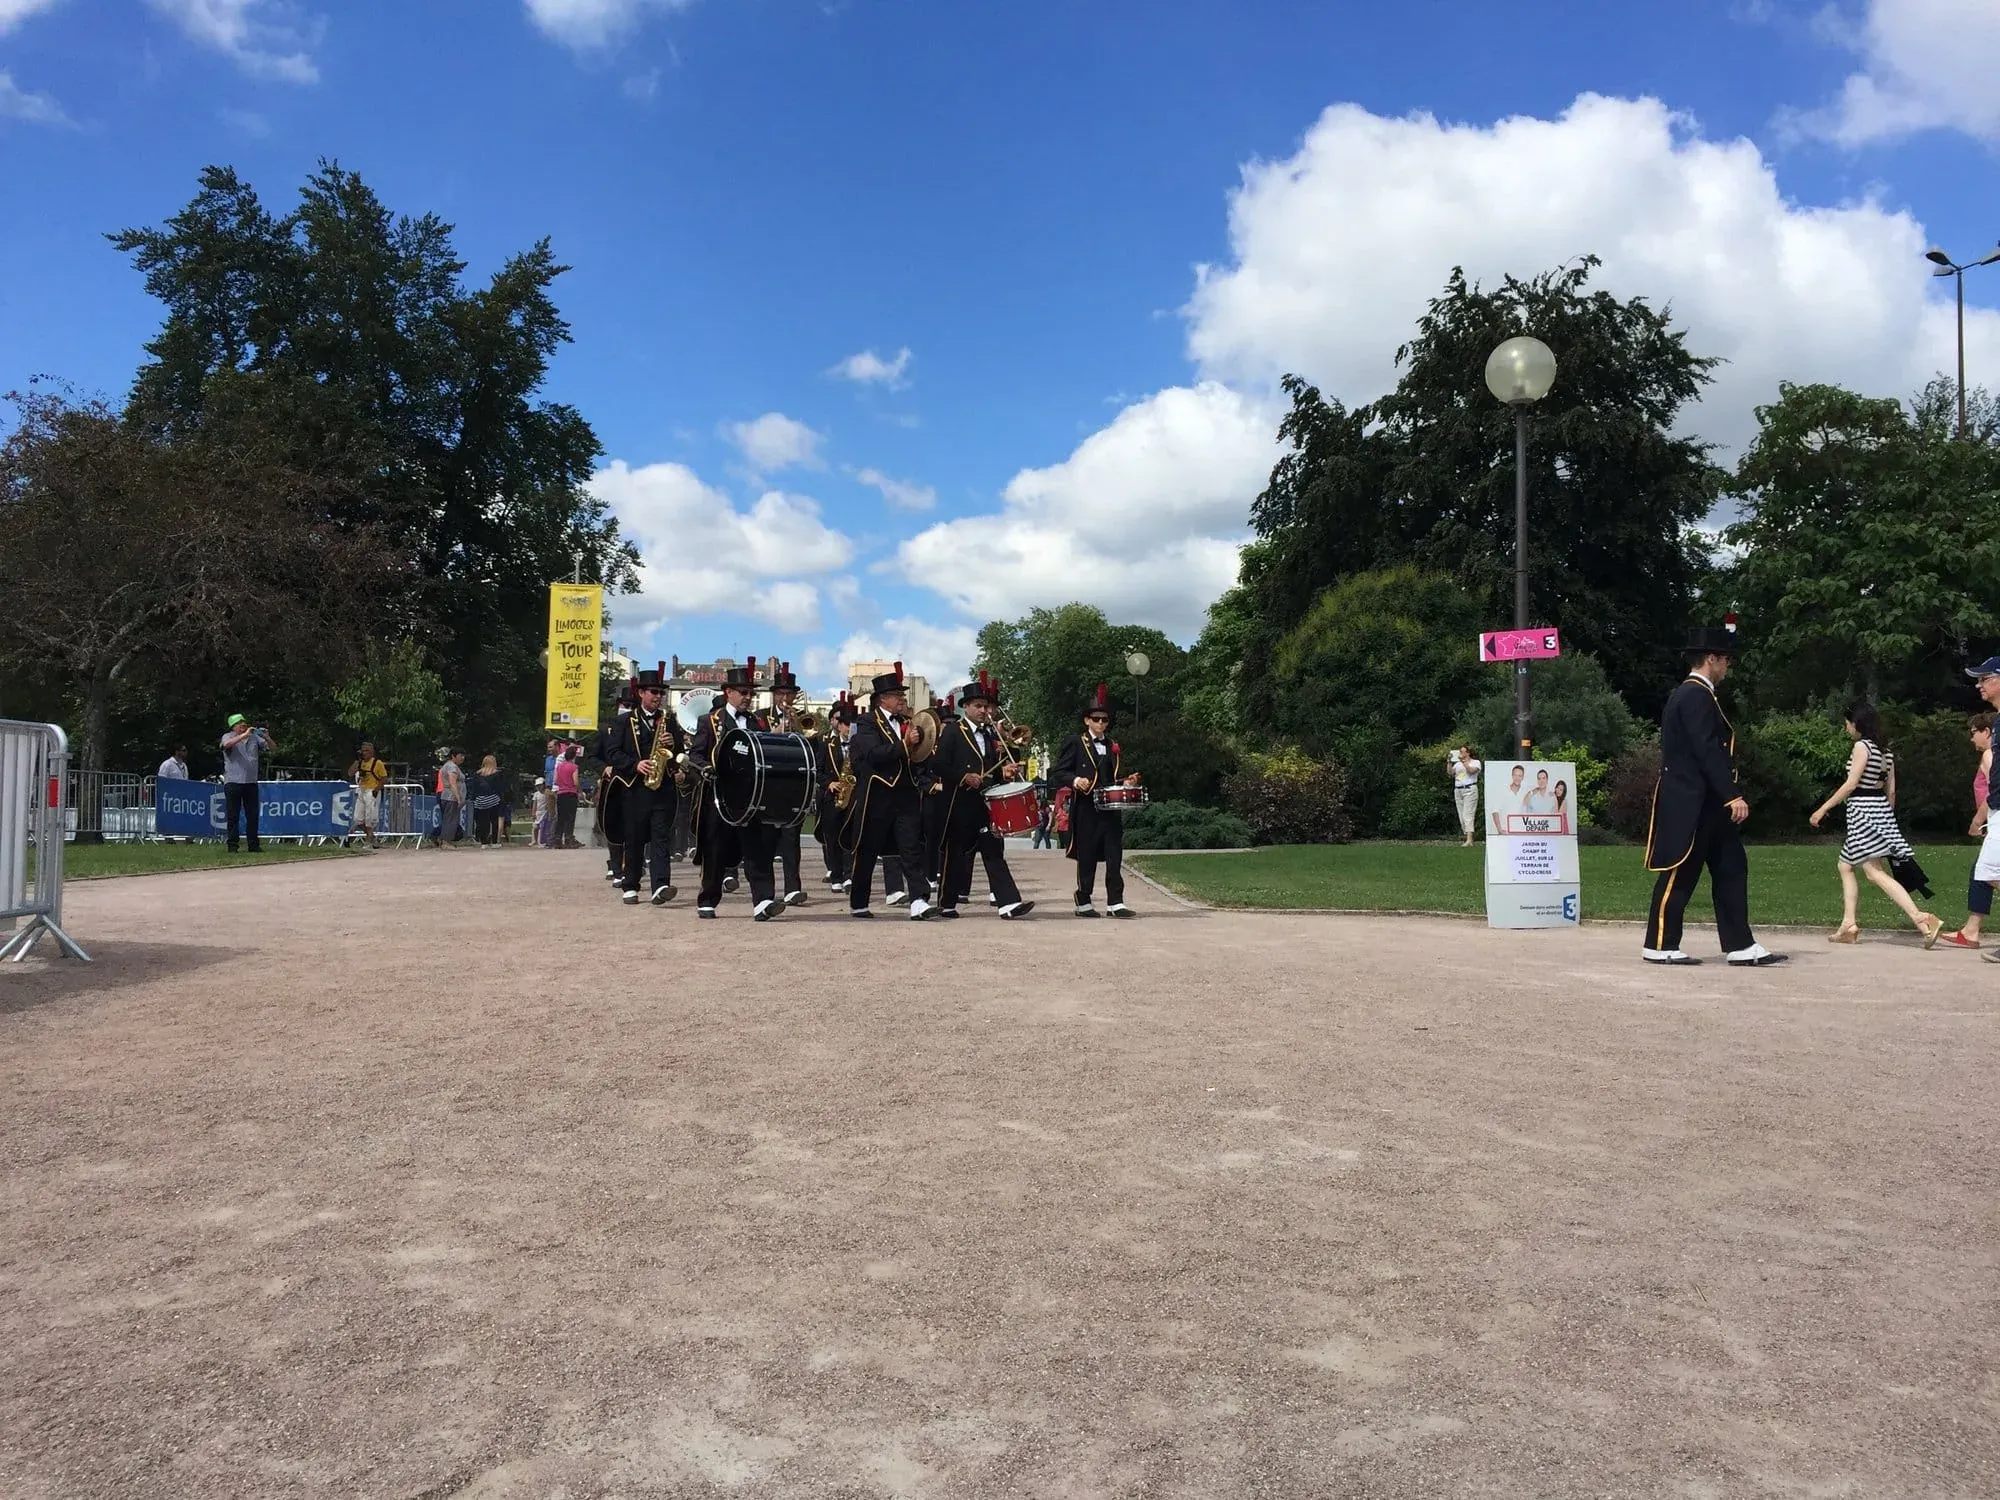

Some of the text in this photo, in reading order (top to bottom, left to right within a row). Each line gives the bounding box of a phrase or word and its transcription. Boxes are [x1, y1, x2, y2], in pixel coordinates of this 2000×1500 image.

[555, 619, 595, 633] LIMOGES
[557, 641, 593, 658] TOUR
[1545, 636, 1556, 649] 3
[560, 672, 587, 681] JUILLET
[162, 792, 206, 817] france
[259, 800, 323, 817] rance
[1522, 816, 1549, 826] VILLAGE
[1564, 896, 1576, 919] 3
